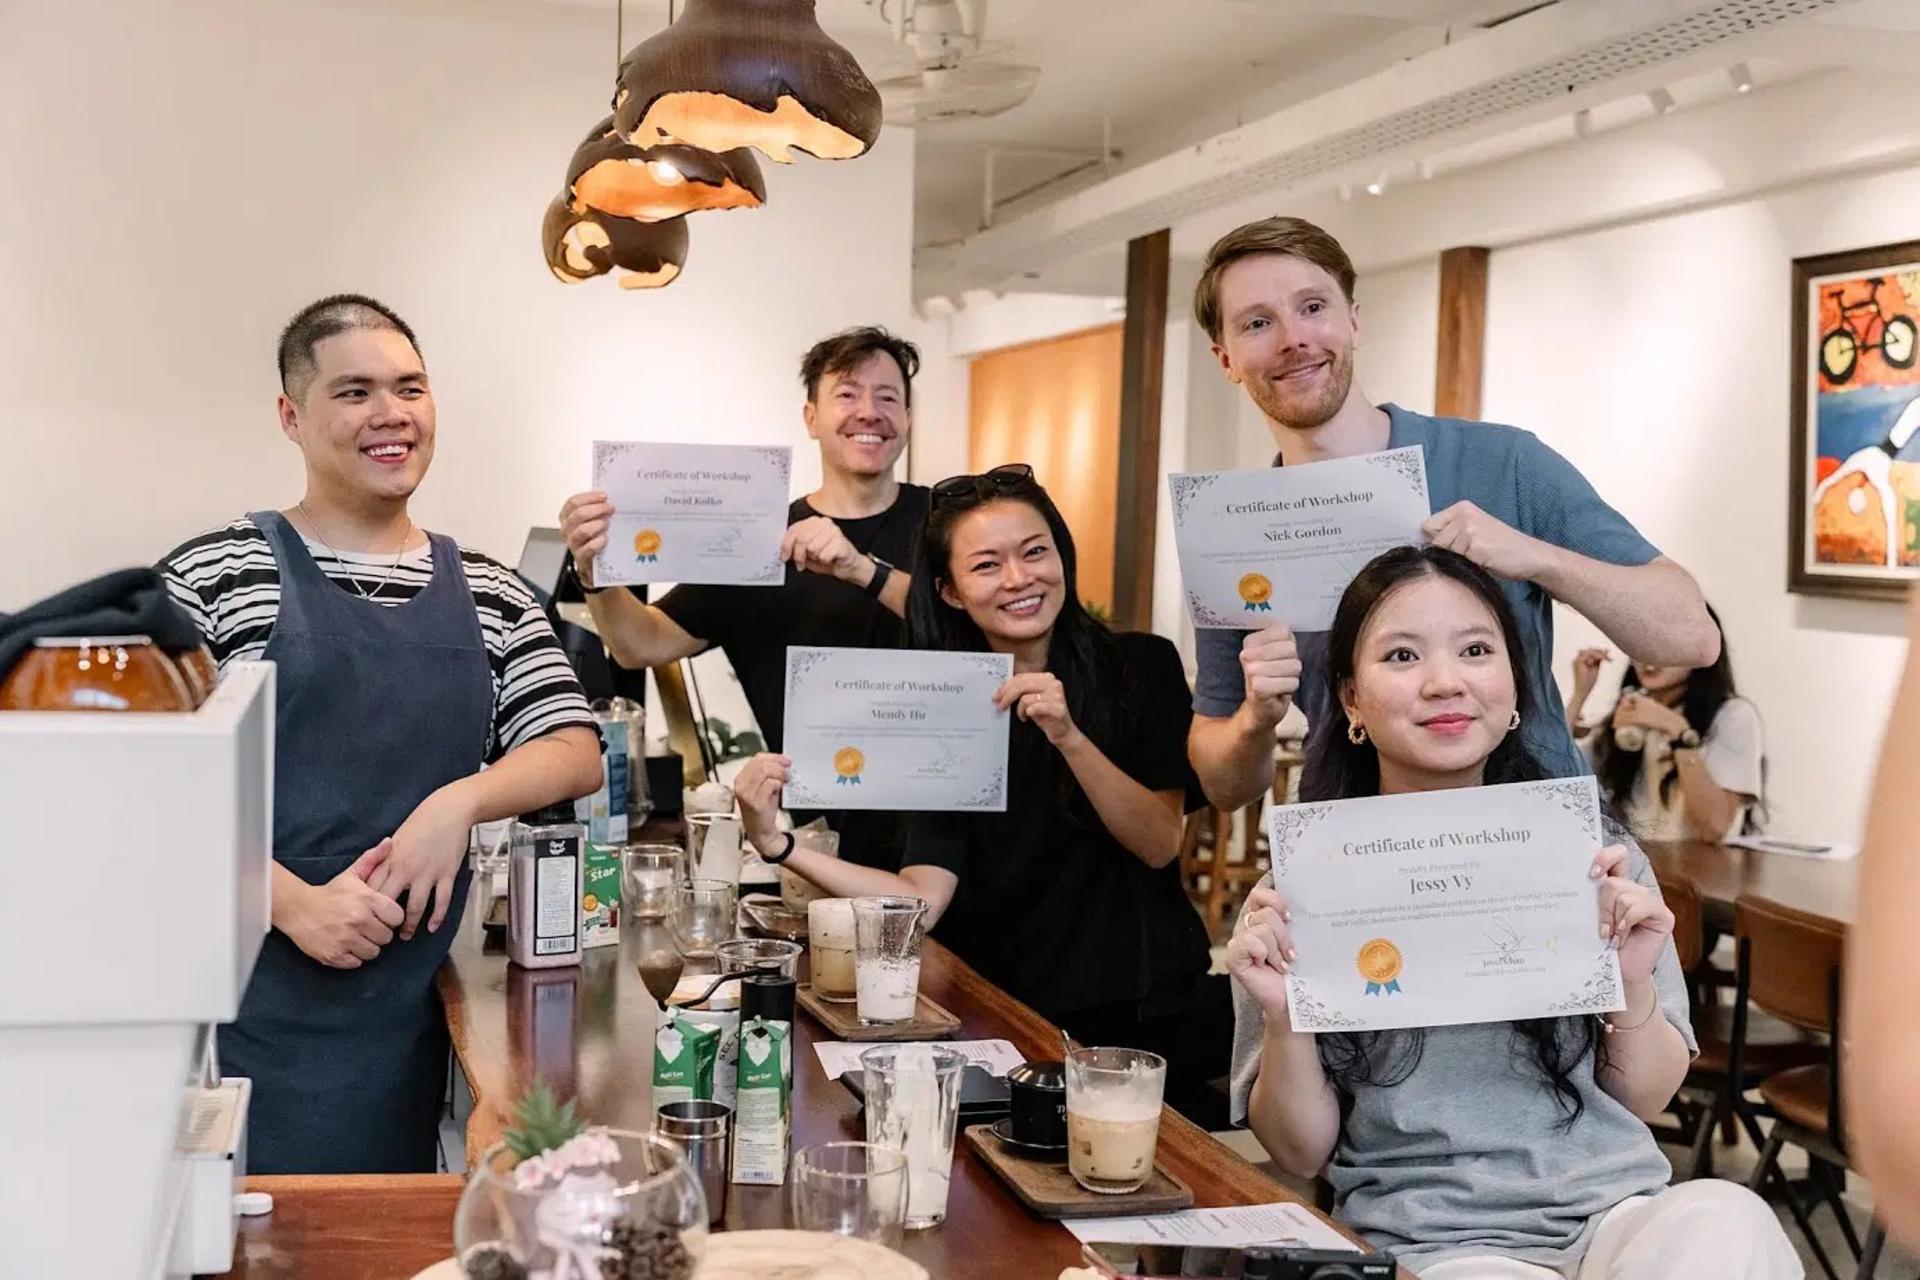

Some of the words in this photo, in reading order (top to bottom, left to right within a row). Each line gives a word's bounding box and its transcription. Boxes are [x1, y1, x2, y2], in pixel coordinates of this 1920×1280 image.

[637, 470, 688, 481] Certificate
[690, 471, 700, 481] of
[702, 471, 751, 483] Workshop
[664, 496, 692, 505] David
[1226, 501, 1290, 514] Certificate
[1293, 498, 1307, 509] of
[1308, 491, 1373, 506] Workshop
[1264, 530, 1291, 542] Nick
[1294, 526, 1342, 540] Gordon
[835, 680, 893, 691] Certificate
[894, 681, 906, 691] of
[908, 682, 963, 694] Workshop
[1343, 838, 1425, 856] Certificate
[1430, 833, 1446, 848] of
[1448, 828, 1531, 846] Workshop
[590, 867, 616, 882] Star
[1410, 879, 1448, 895] Jessy
[1453, 874, 1472, 890] Vy
